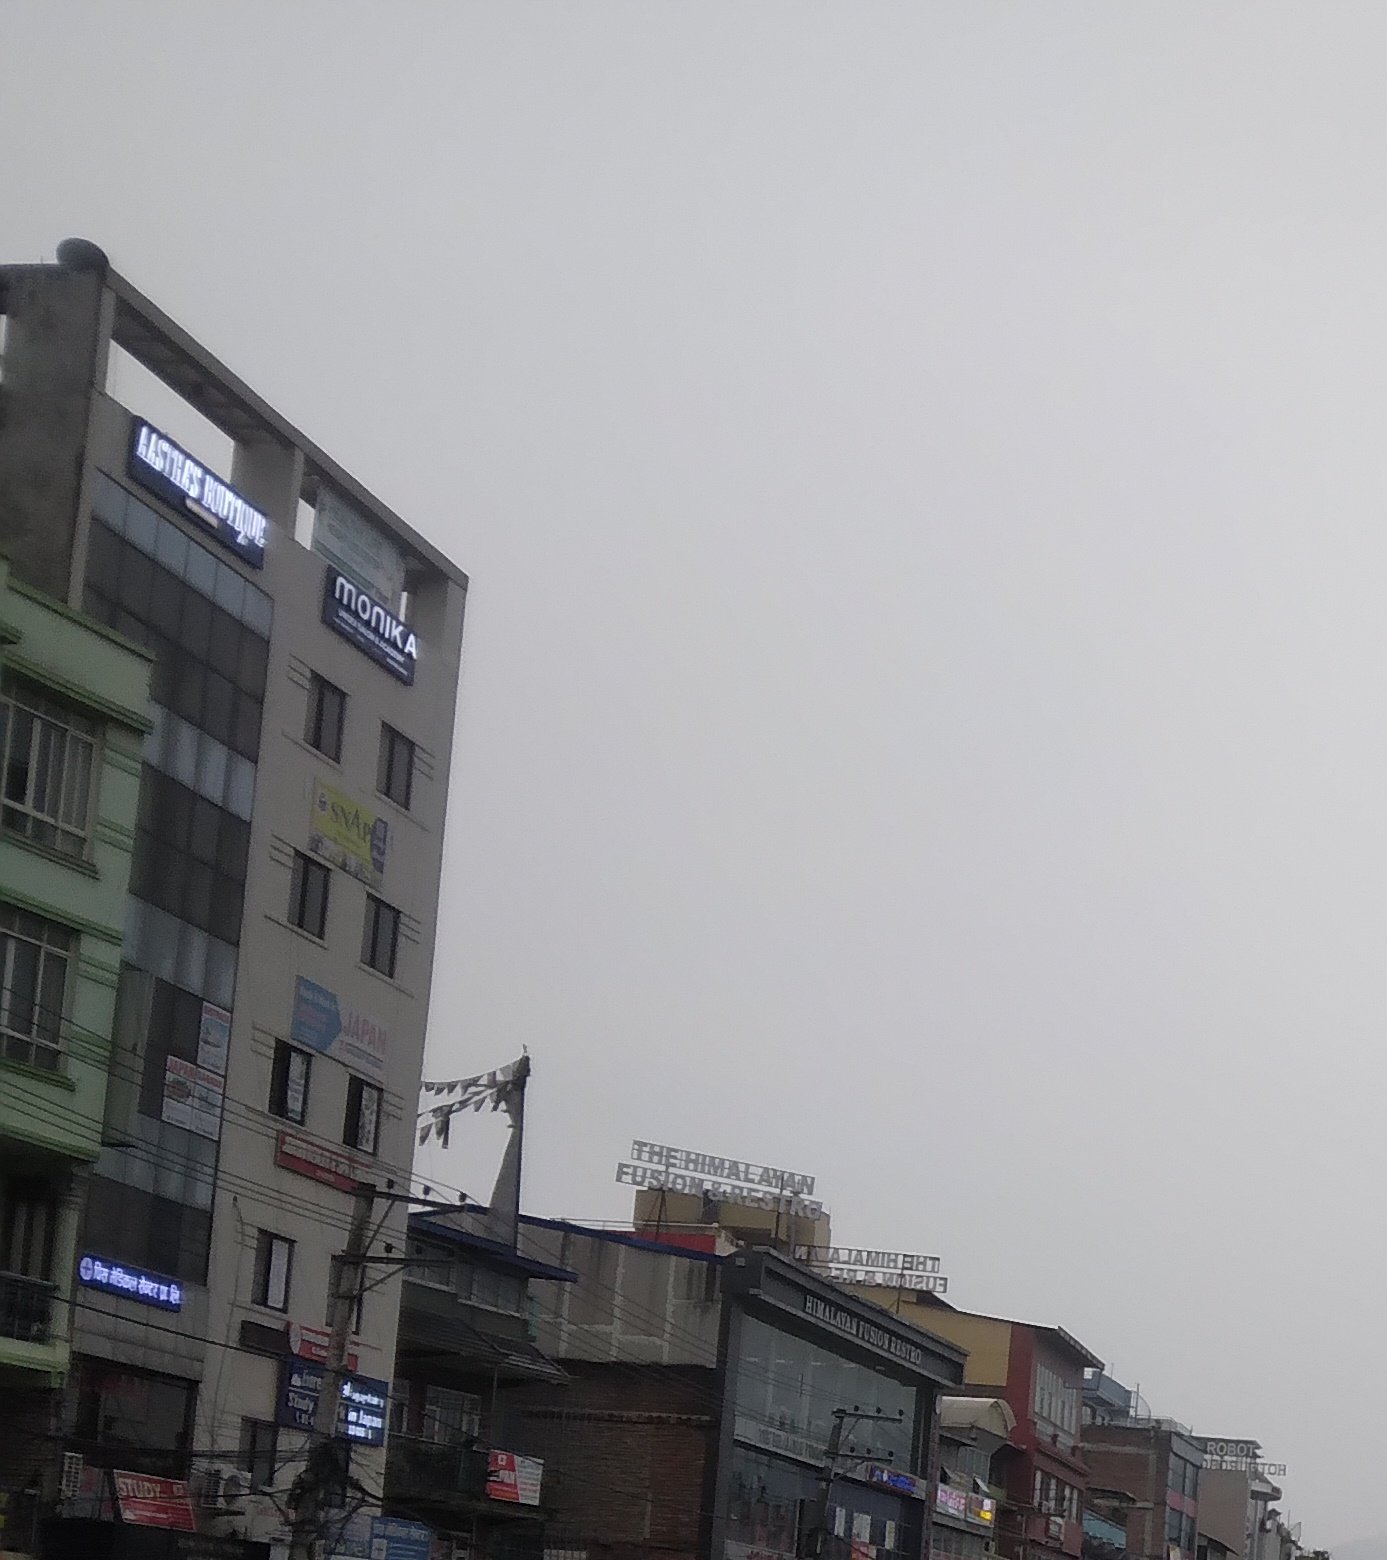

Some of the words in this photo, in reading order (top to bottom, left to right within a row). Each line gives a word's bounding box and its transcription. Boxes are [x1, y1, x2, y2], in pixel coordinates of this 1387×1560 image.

[615, 1162, 704, 1197] FUSION
[729, 1185, 823, 1221] RESTRO
[630, 1139, 680, 1168] THE
[680, 1150, 817, 1196] HIMALAYAN
[804, 1294, 858, 1336] HIMALAYAN
[858, 1320, 891, 1351] FUSION
[890, 1335, 923, 1365] RESTRO
[1206, 1441, 1257, 1457] ROBOT
[118, 1476, 161, 1499] STUDY
